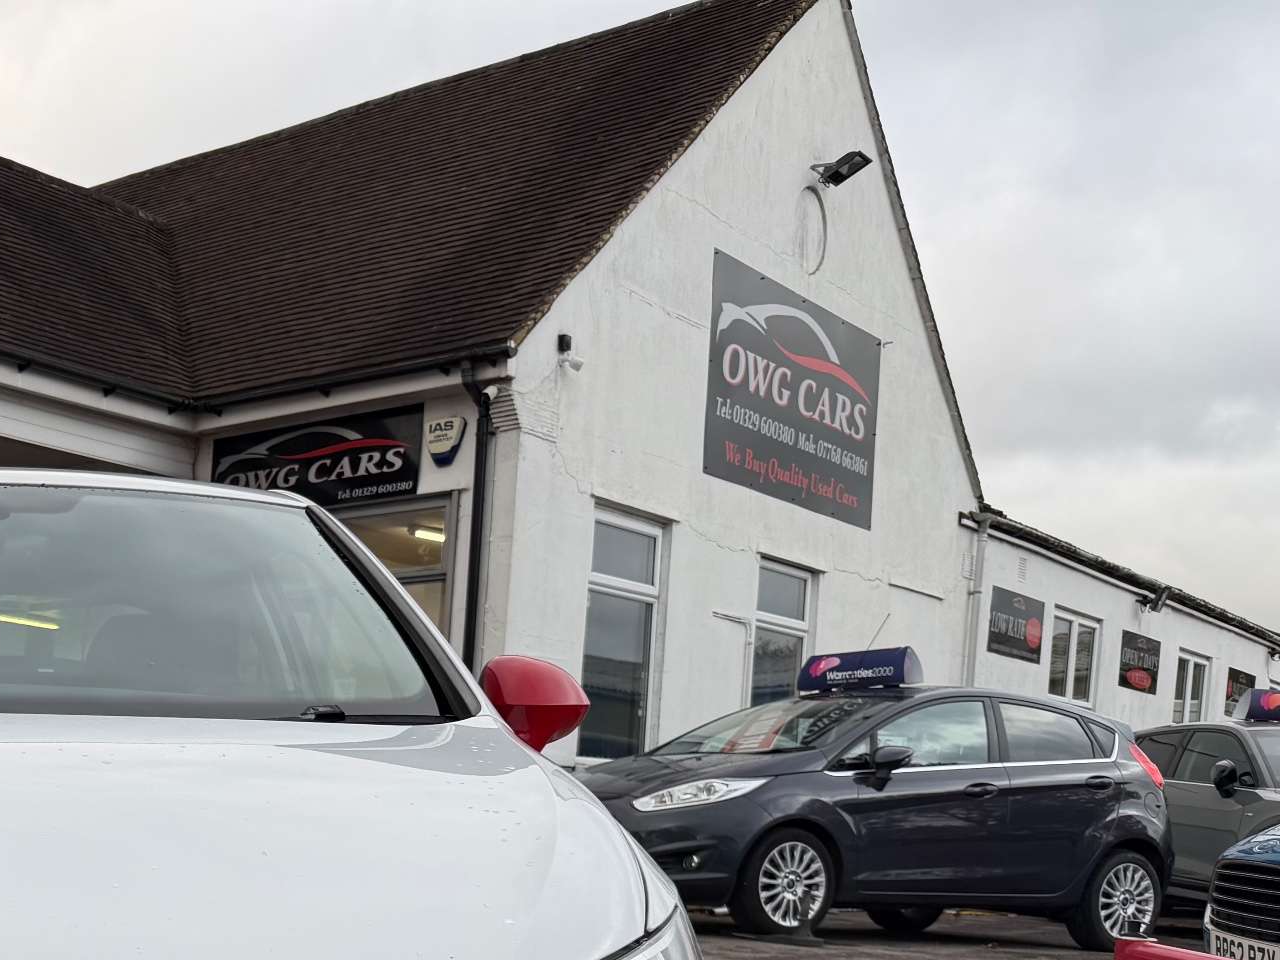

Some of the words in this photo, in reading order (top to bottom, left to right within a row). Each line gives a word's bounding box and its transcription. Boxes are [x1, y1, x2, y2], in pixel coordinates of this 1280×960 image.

[722, 343, 791, 406] OWG
[798, 379, 867, 441] CARS
[428, 420, 454, 434] IAS
[716, 396, 732, 420] Tel:
[733, 405, 759, 431] 01329
[761, 416, 795, 445] 600380
[817, 440, 841, 464] 07768
[307, 447, 405, 483] CARS
[725, 441, 740, 466] We
[745, 448, 767, 483] Buy
[768, 458, 809, 498] Quality
[811, 473, 836, 499] Used
[836, 483, 859, 508] Cars
[352, 486, 377, 498] 01329
[378, 481, 413, 494] 600380
[991, 611, 1009, 634] LOW
[1008, 616, 1025, 640] RATE
